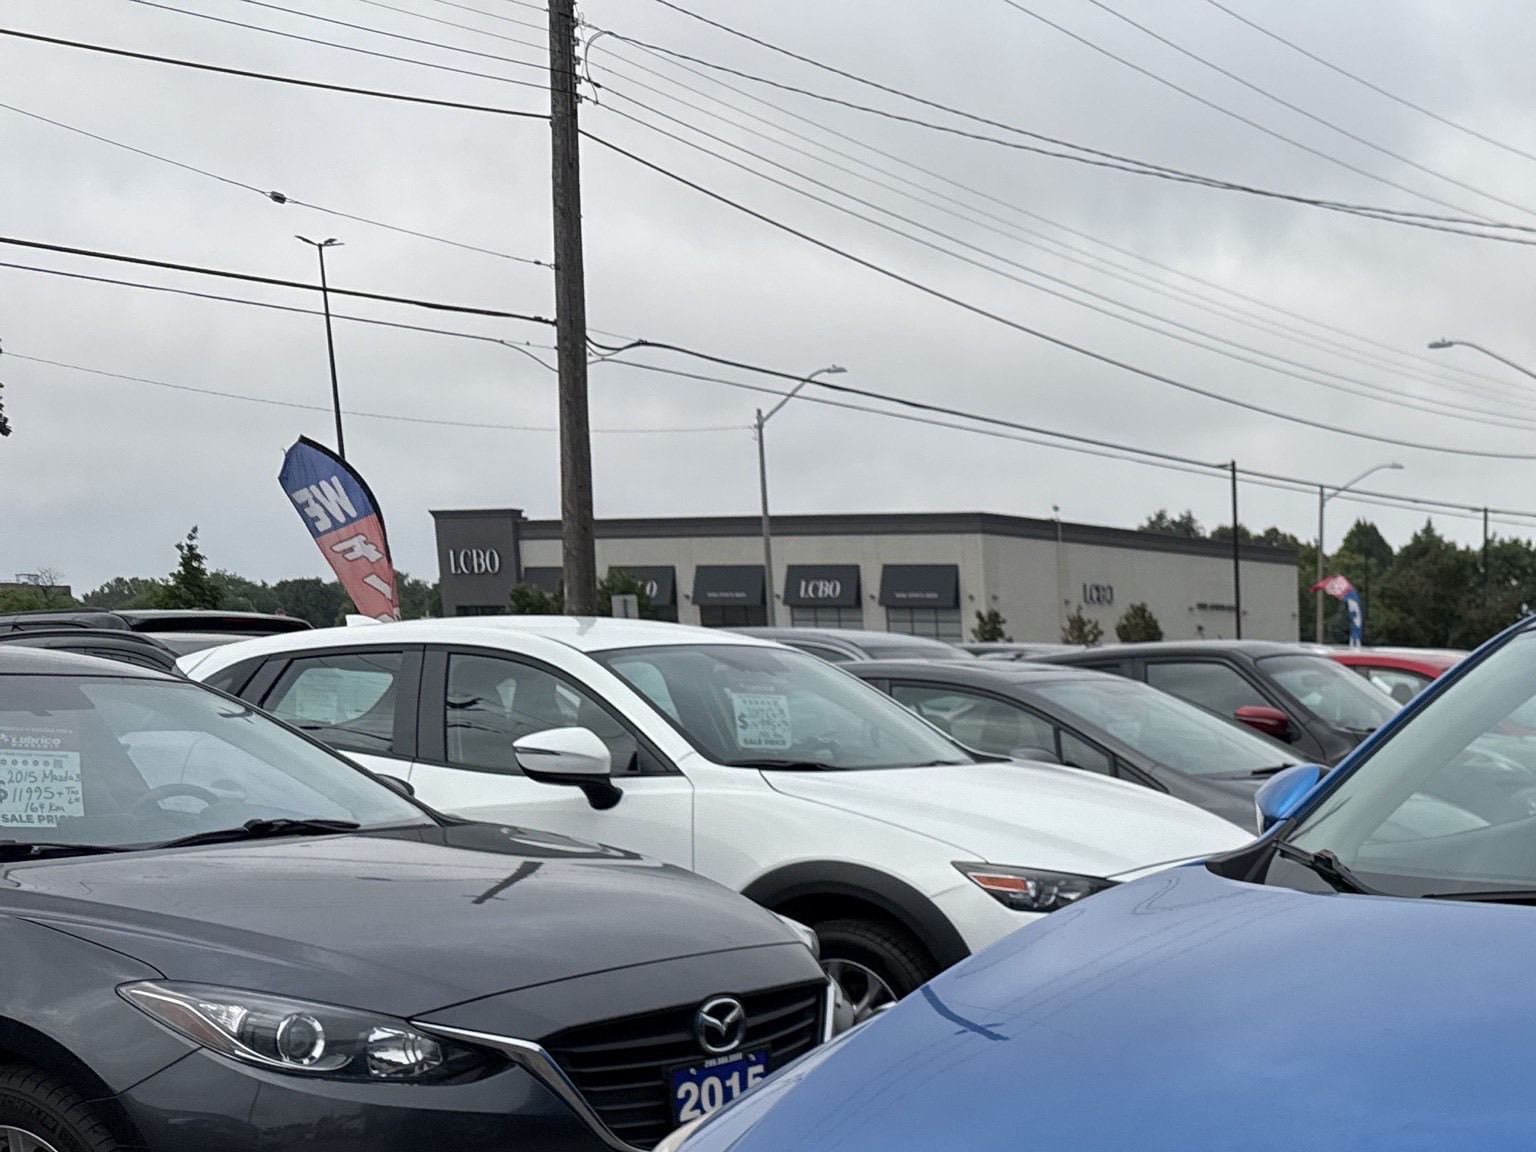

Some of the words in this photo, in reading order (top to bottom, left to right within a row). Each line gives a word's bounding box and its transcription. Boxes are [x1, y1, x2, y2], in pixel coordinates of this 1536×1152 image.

[449, 548, 500, 574] LCBO
[800, 579, 841, 599] LCBO
[7, 770, 38, 784] 2015
[1, 814, 35, 824] SALE
